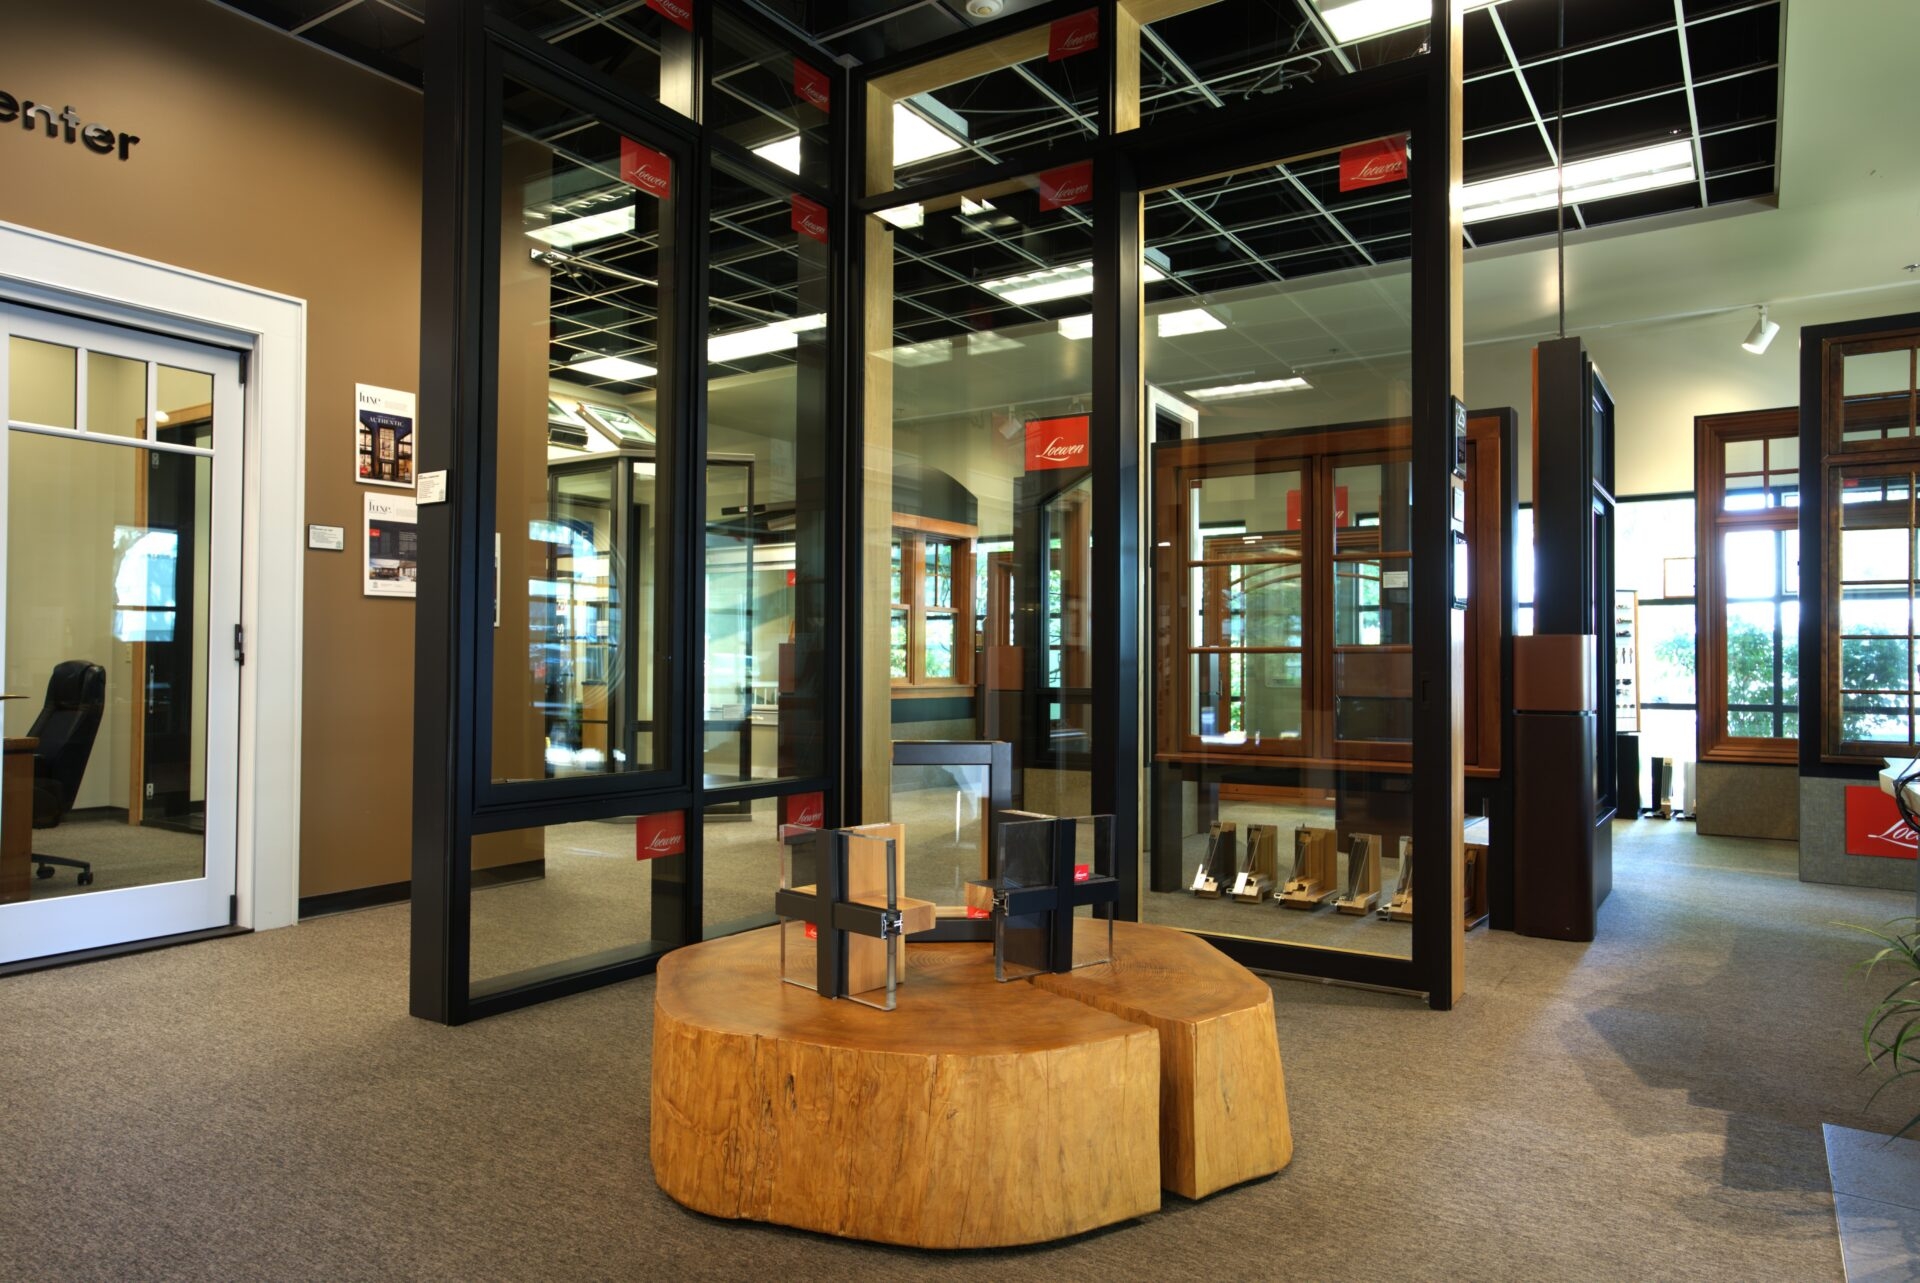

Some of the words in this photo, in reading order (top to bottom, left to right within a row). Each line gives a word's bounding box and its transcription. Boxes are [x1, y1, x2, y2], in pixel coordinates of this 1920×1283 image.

[629, 164, 668, 189] Loewen
[1350, 156, 1402, 181] Loewen
[1047, 180, 1089, 202] Loewen
[1034, 436, 1086, 462] Loewen
[643, 829, 683, 852] Loewen
